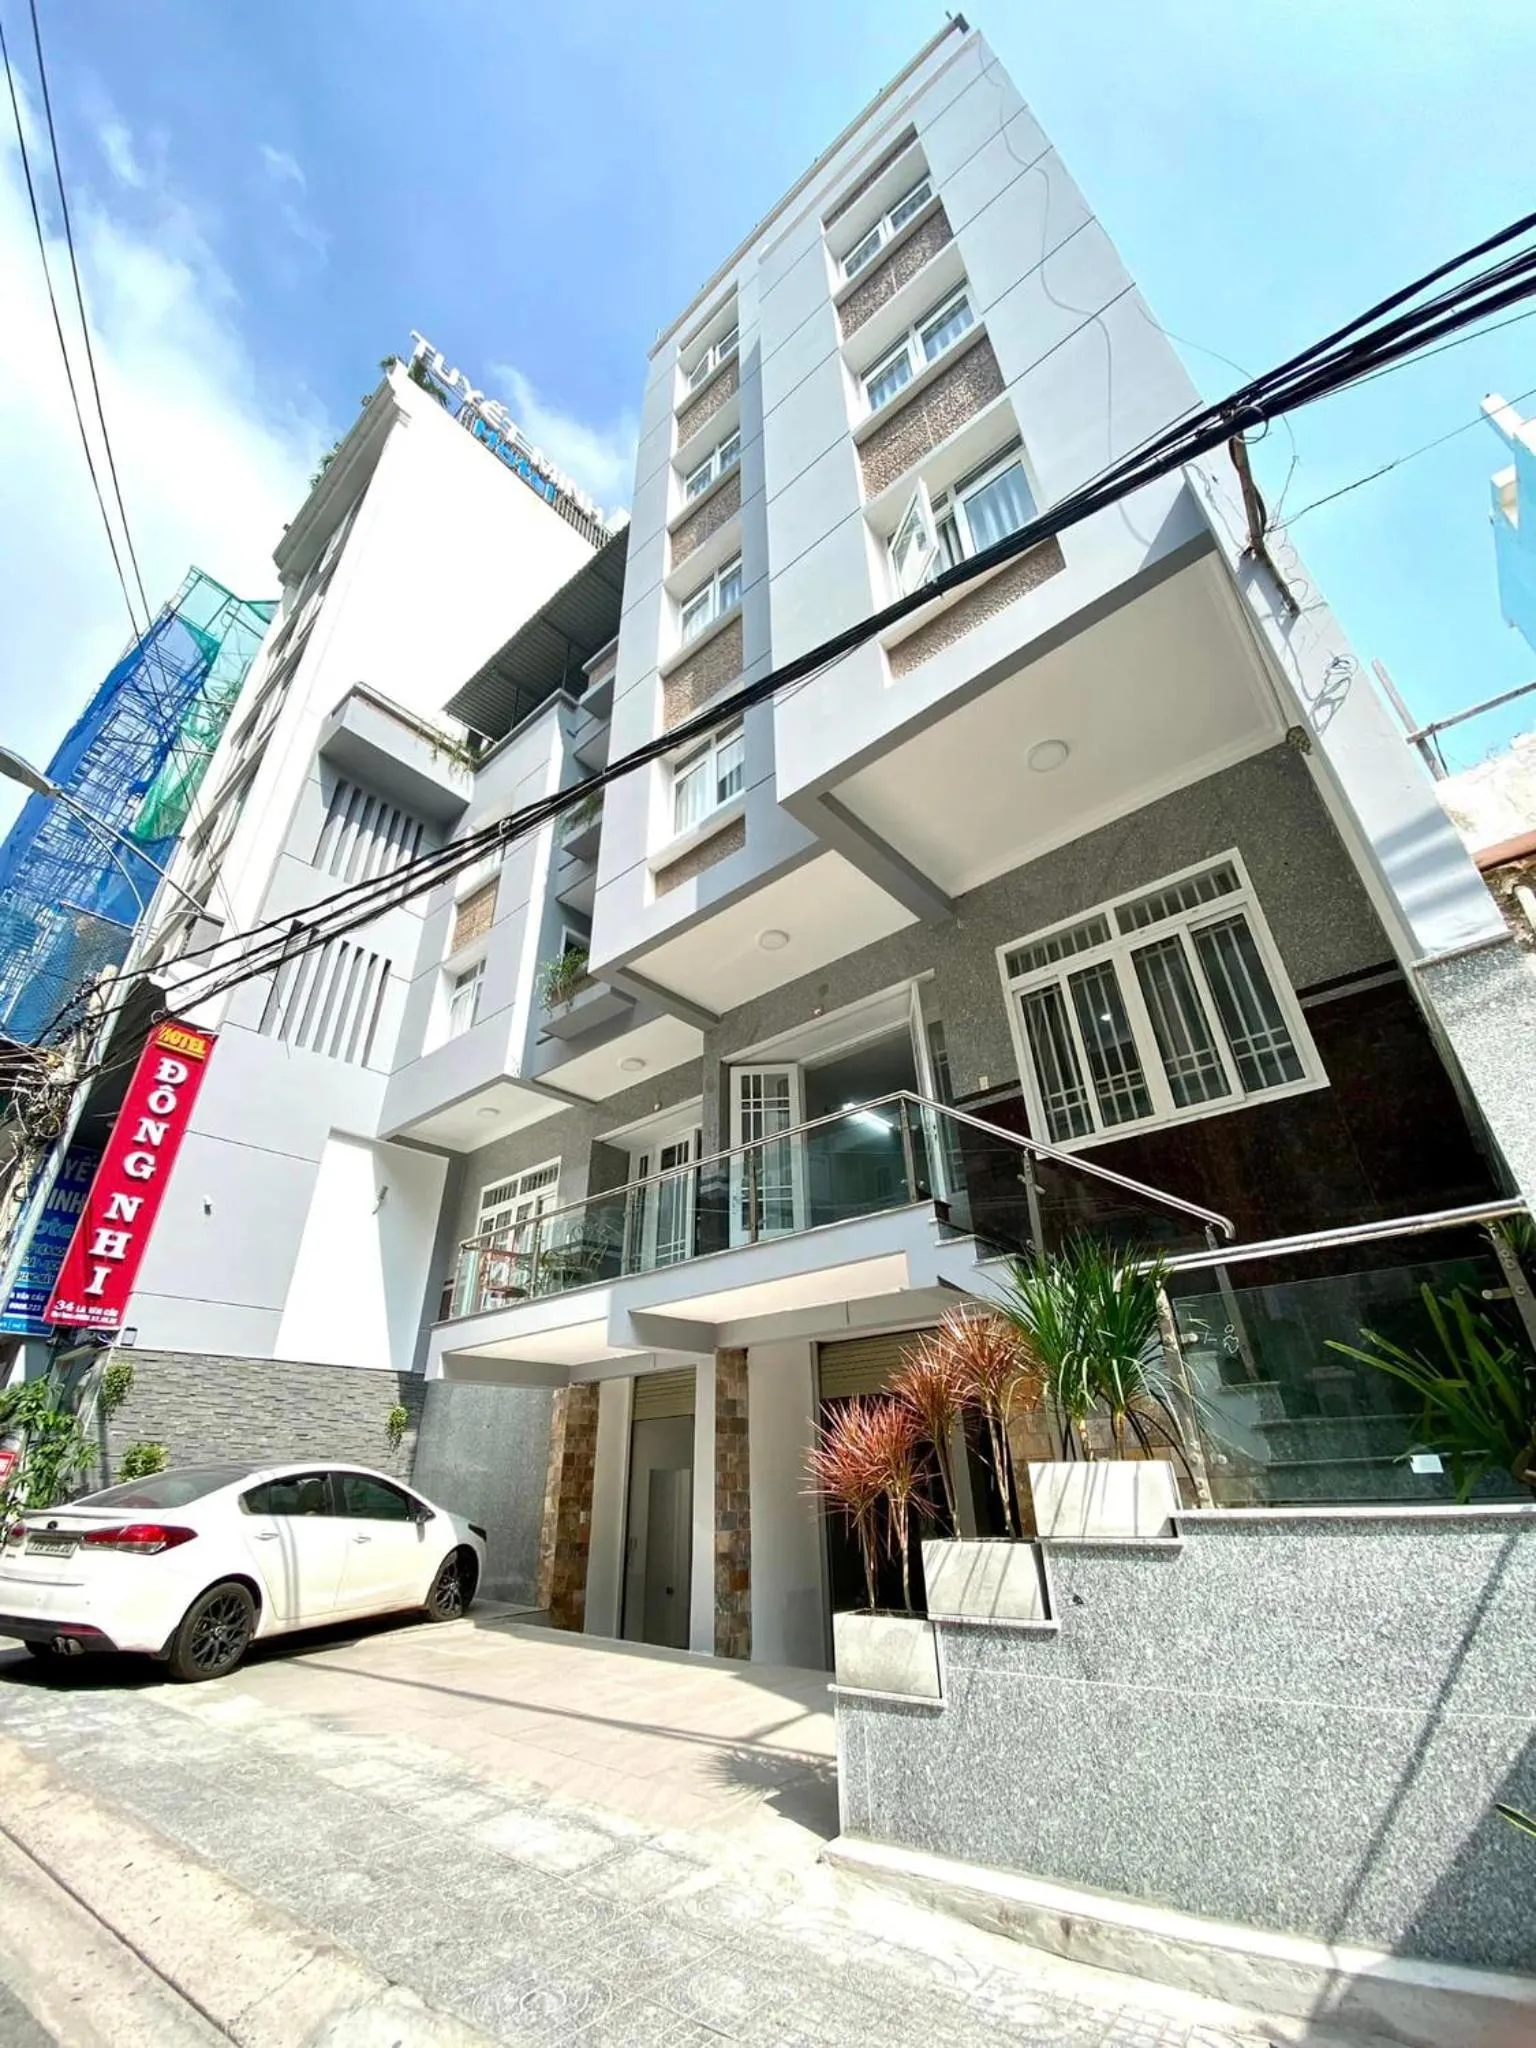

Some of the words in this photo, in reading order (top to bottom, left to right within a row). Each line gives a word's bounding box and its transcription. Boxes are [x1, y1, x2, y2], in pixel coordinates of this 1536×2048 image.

[159, 1025, 206, 1055] HOTEL
[123, 1057, 188, 1180] ĐÔNG
[84, 1192, 144, 1295] NHI
[55, 1299, 75, 1312] 34
